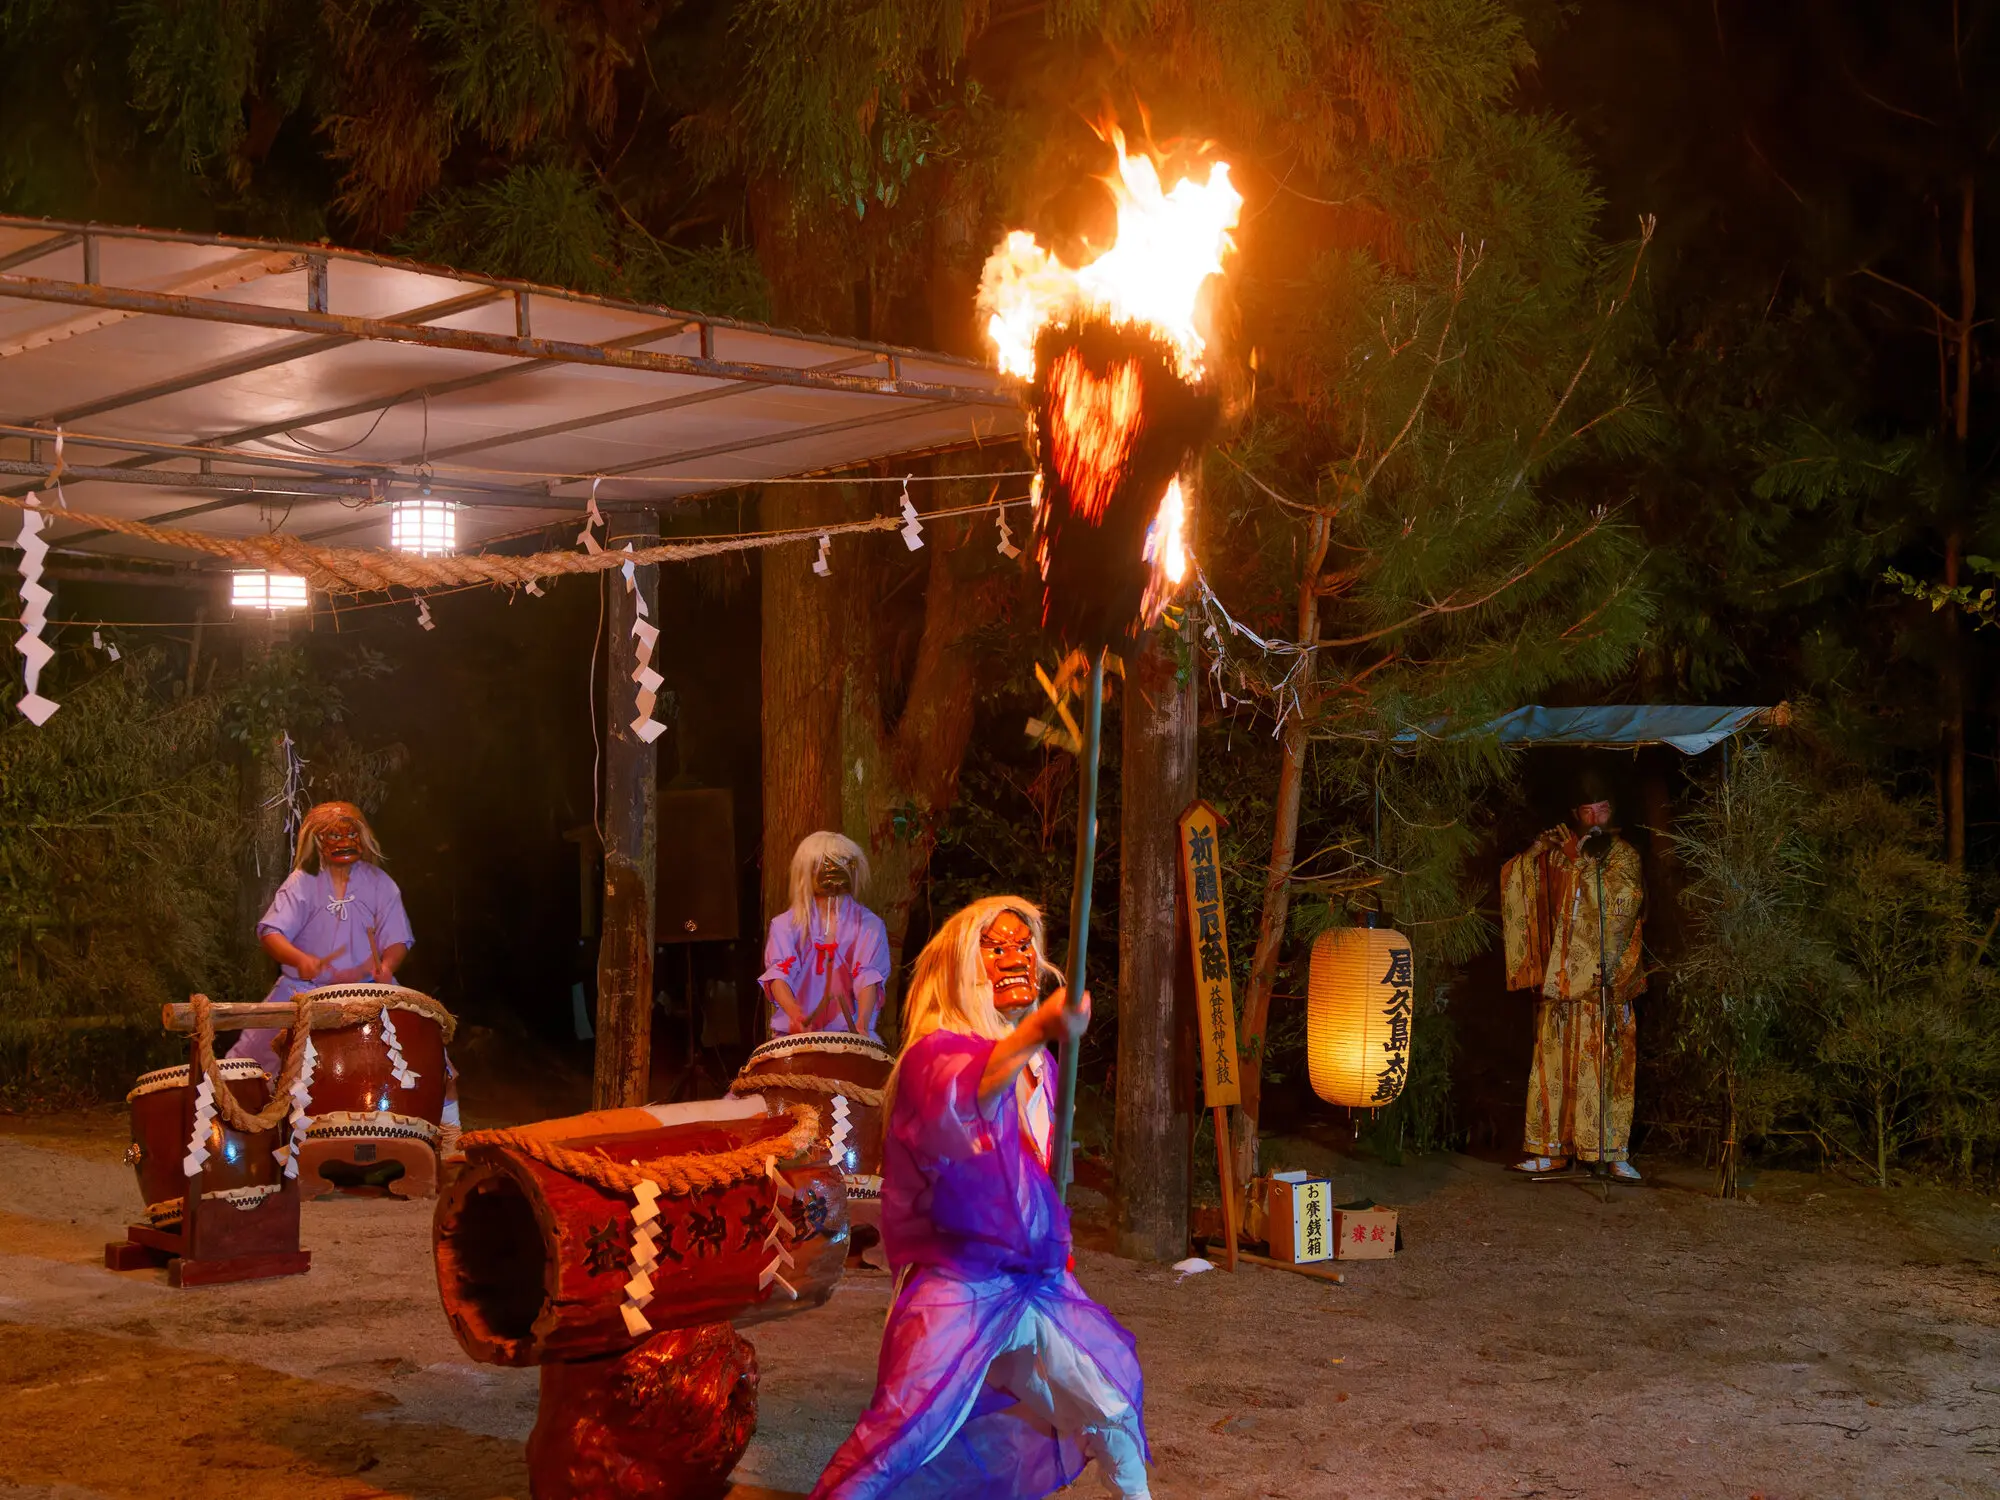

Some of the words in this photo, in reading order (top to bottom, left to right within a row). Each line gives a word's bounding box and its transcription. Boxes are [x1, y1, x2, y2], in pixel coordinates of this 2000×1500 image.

[1189, 824, 1227, 983] 祈願厄除
[1209, 984, 1233, 1086] 益救神太鼓
[1370, 949, 1412, 1102] 屋久島太鼓
[1306, 1183, 1322, 1256] お賽銭箱
